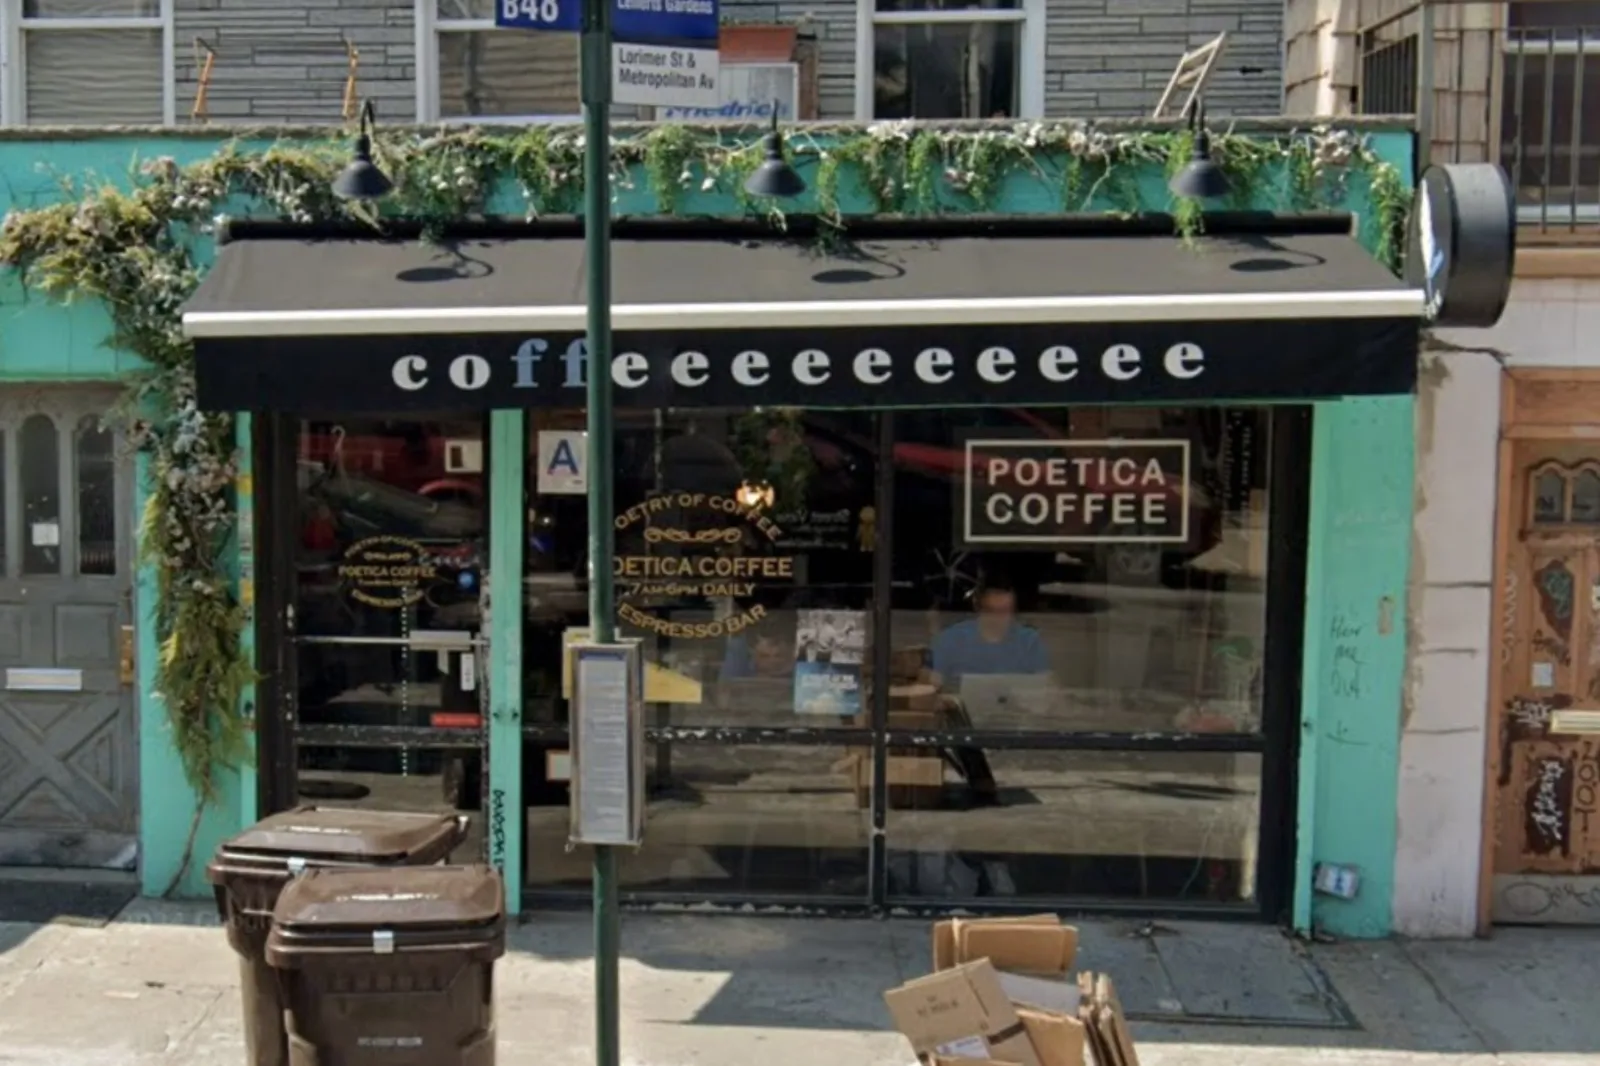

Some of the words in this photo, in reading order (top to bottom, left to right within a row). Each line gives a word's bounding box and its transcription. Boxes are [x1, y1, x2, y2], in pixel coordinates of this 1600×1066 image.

[618, 47, 667, 66] Lorimer
[670, 50, 684, 68] St
[686, 52, 696, 68] &
[618, 68, 696, 88] Metropolitan
[700, 73, 714, 89] Av
[548, 439, 579, 475] A
[988, 458, 1165, 486] POETICA
[613, 495, 673, 530] OETRY
[678, 493, 705, 508] OF
[708, 496, 782, 541] COFFEE
[986, 493, 1167, 525] COFFEE
[613, 557, 693, 576] OETICA
[698, 557, 793, 577] COFFEE
[702, 582, 757, 596] DAILY
[617, 603, 722, 639] ESPRESSO
[726, 603, 767, 634] BAR
